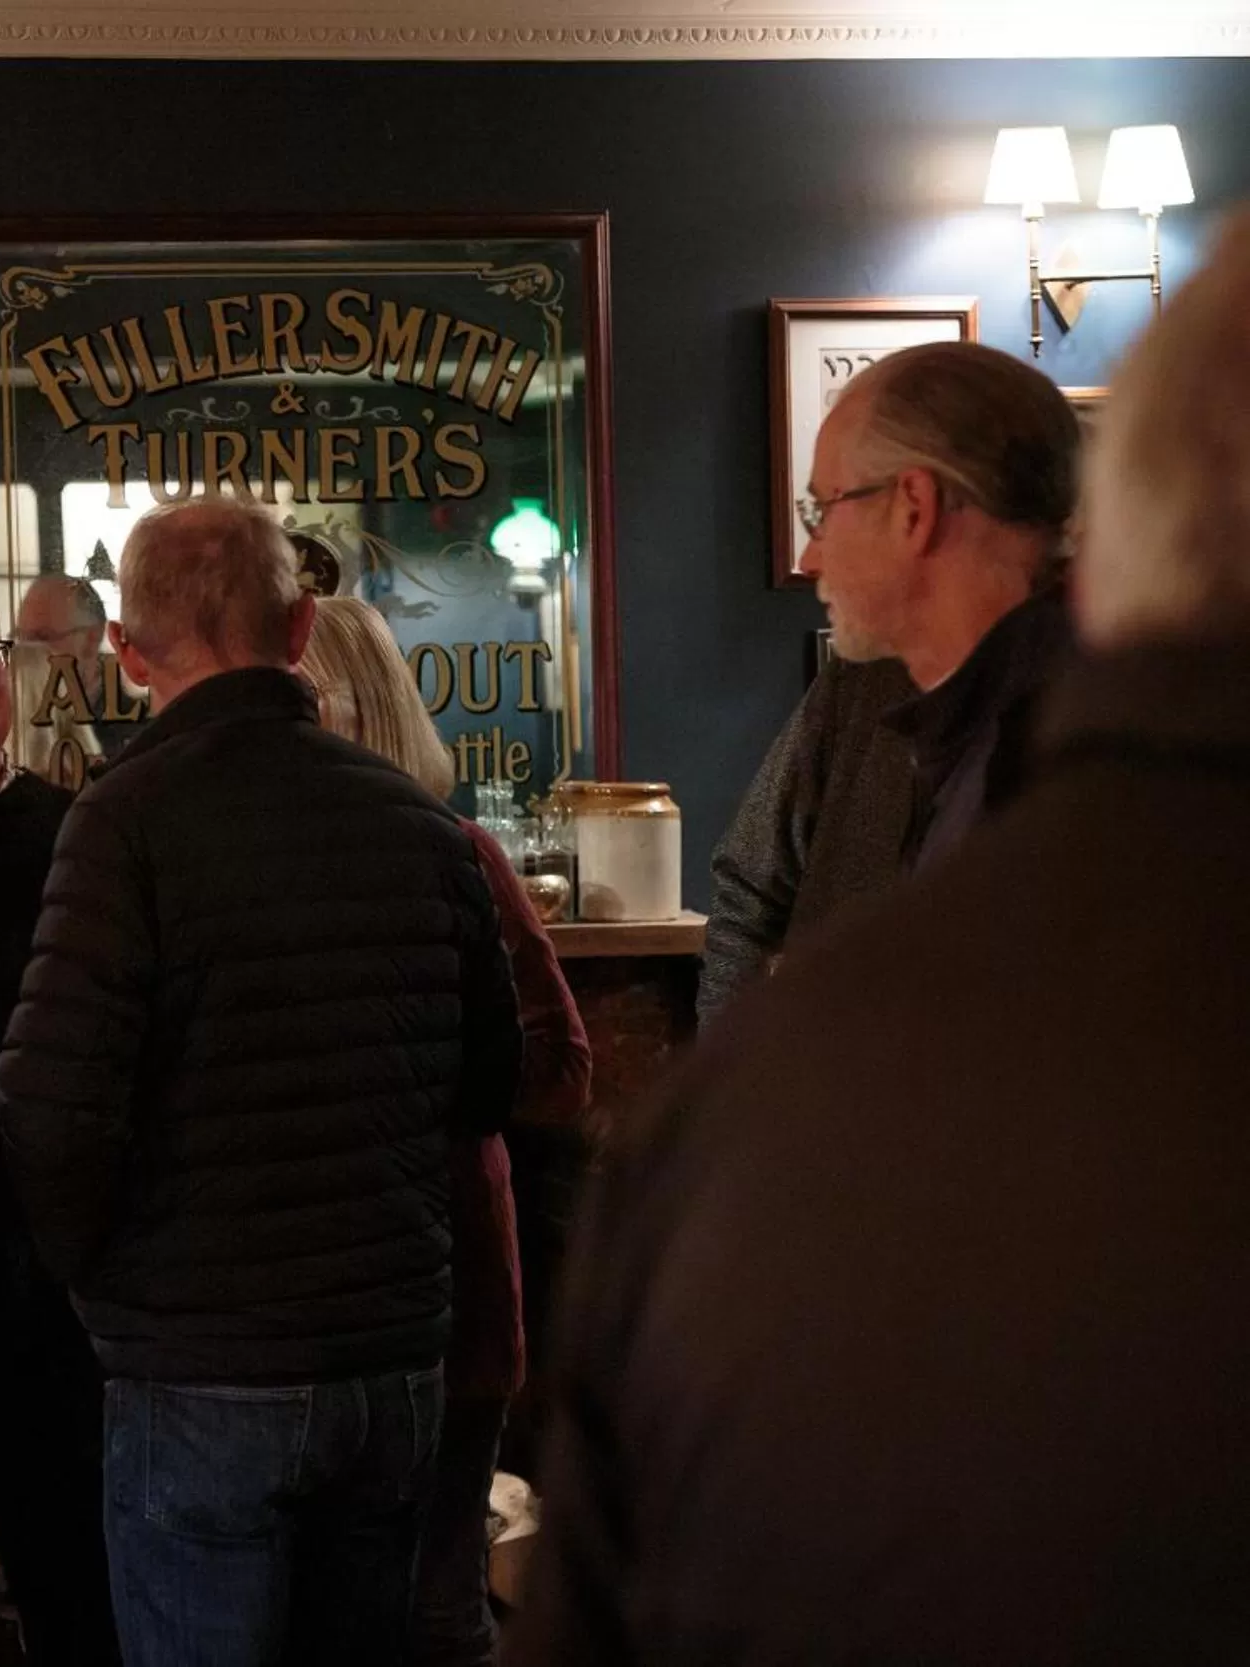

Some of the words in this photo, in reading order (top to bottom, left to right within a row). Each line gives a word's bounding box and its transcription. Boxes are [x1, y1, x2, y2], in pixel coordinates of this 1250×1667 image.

[319, 288, 544, 422] SMITH
[271, 382, 305, 415] &
[31, 654, 150, 726] AL
[402, 640, 552, 715] OUT
[450, 726, 532, 786] ttle
